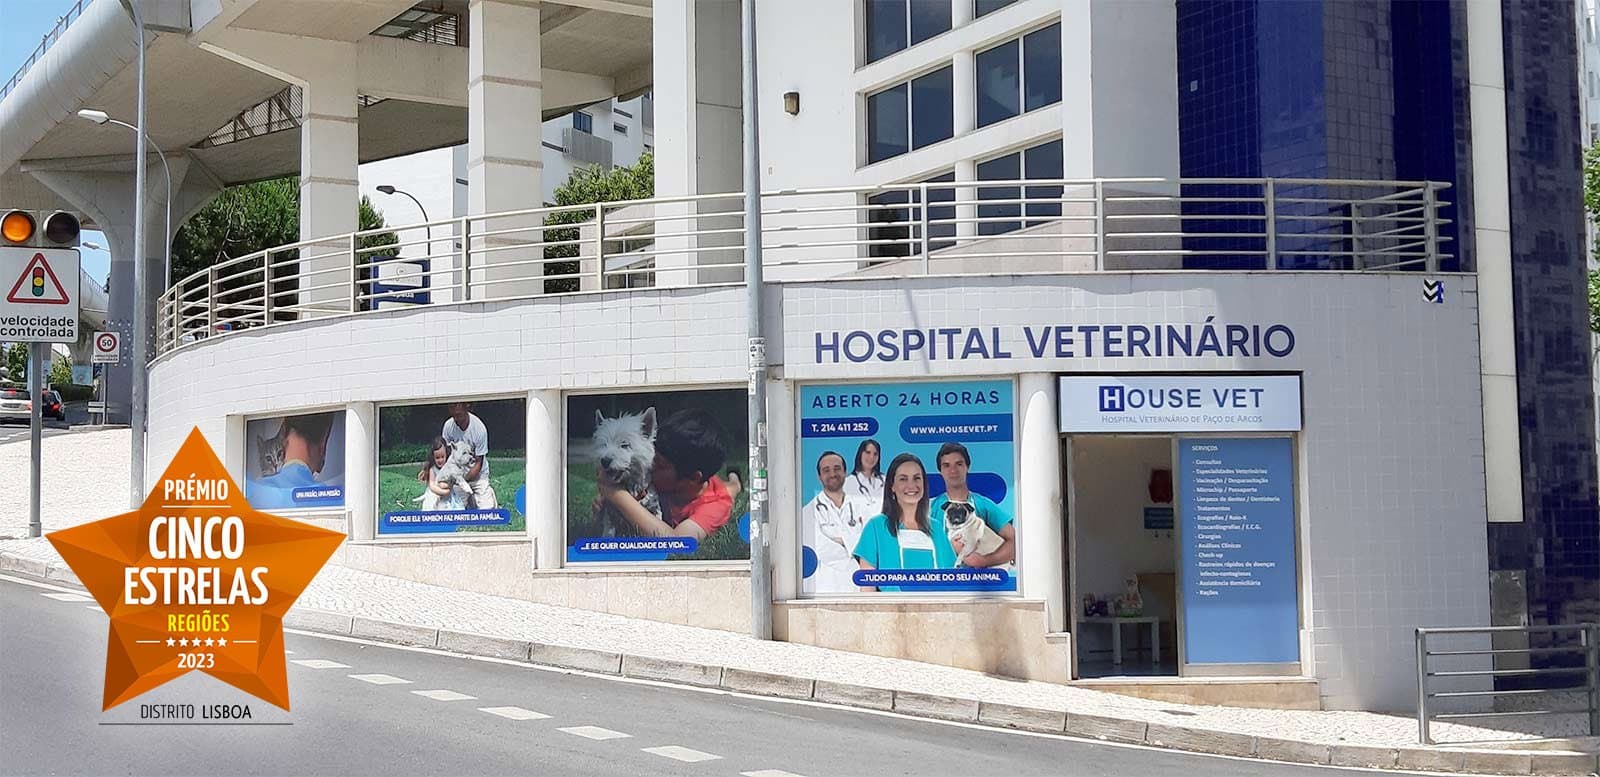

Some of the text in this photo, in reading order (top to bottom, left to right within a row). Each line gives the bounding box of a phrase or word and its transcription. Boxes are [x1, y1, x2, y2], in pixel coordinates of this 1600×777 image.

[0, 316, 74, 327] velocidade
[0, 327, 74, 337] controlada
[102, 339, 112, 347] 50
[815, 316, 1295, 363] HOSPITAL VETERINÁRIO
[812, 390, 1000, 409] ABERTO 24 HORAS
[1099, 386, 1264, 411] HOUSE VET
[811, 423, 869, 432] T. 214 411 252
[910, 425, 998, 434] WWW.HOUSEVET.PT
[591, 542, 600, 550] SE
[600, 542, 618, 550] QUER
[619, 541, 657, 550] QUALIDADE
[658, 541, 668, 549] DE
[887, 574, 907, 582] PARA
[915, 572, 941, 581] SAÚDE
[942, 573, 955, 581] DO
[956, 573, 971, 581] SEU
[971, 573, 1001, 581] ANIMAL
